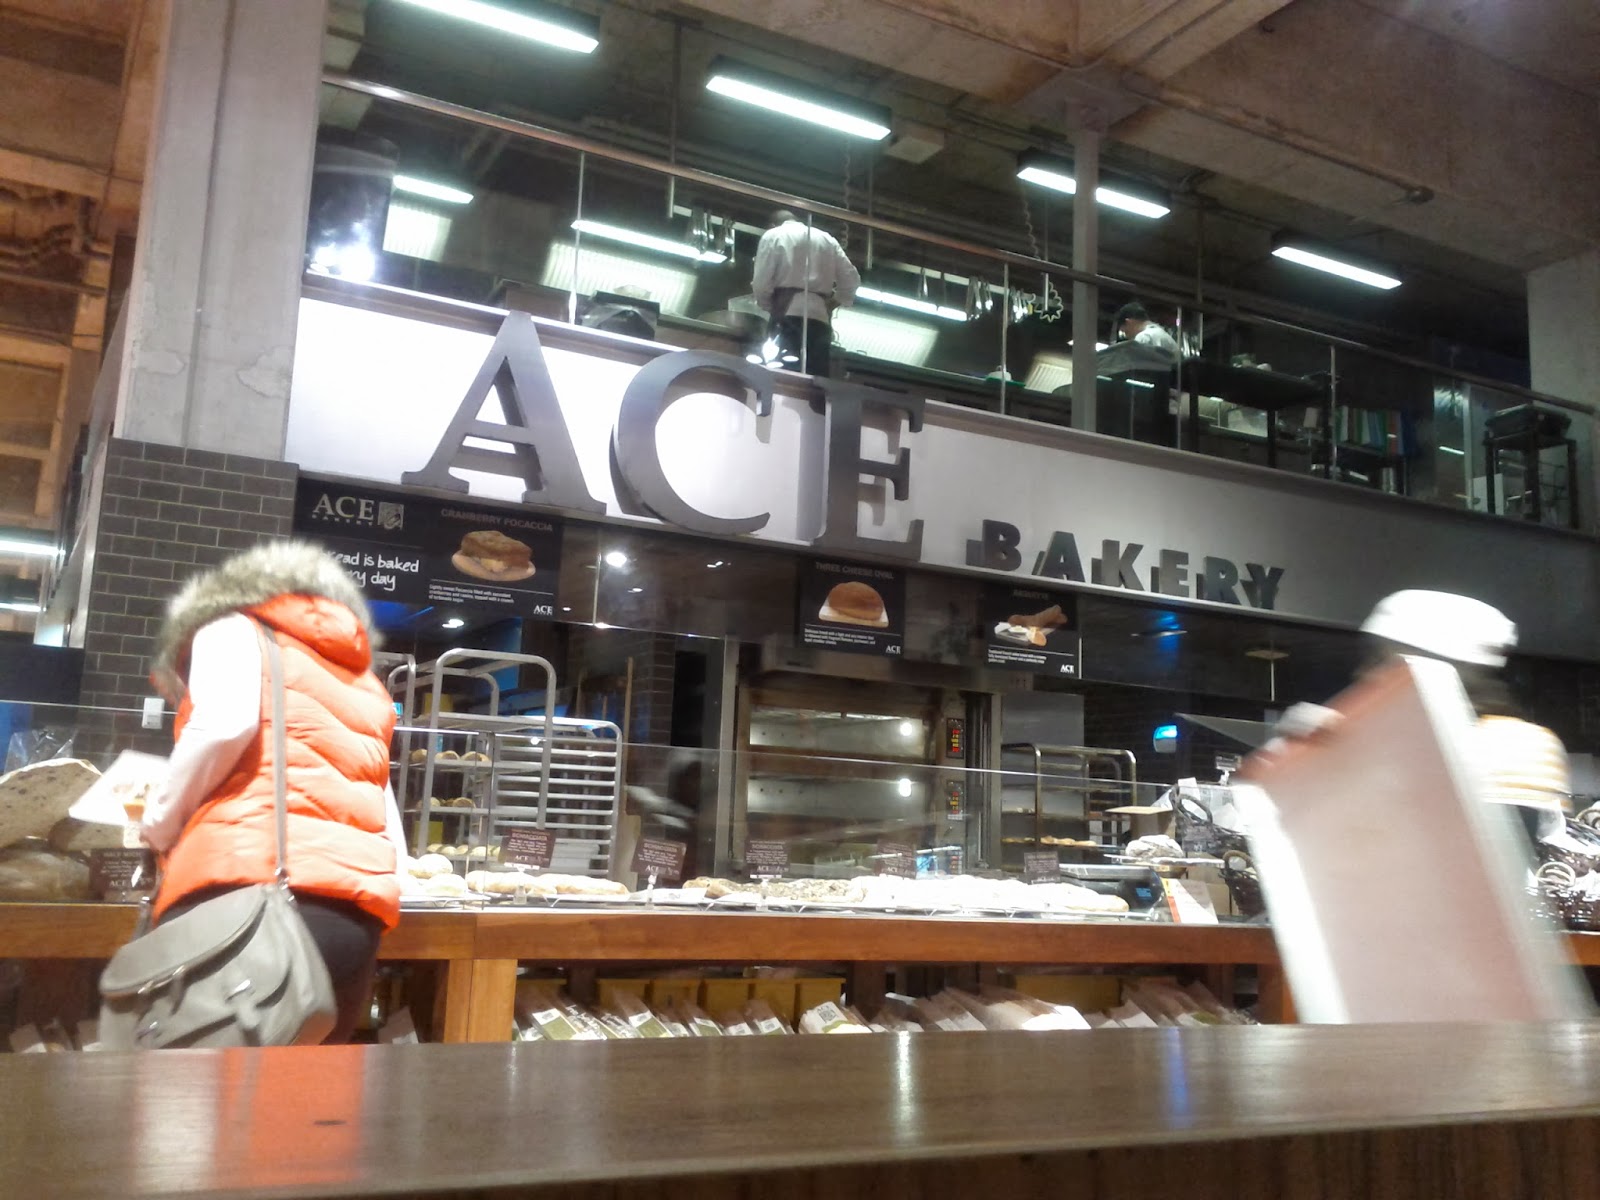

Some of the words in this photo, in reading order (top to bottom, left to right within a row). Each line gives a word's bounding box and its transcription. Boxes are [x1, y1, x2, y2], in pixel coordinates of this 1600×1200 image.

[402, 310, 926, 563] ACE
[980, 518, 1286, 610] BAKERY
[312, 493, 375, 521] ACE
[441, 508, 501, 525] CRANBERRY
[503, 517, 553, 531] FOCACCIA
[363, 553, 375, 567] is
[377, 553, 420, 573] baked
[370, 571, 397, 592] day
[534, 604, 554, 613] ACE
[885, 645, 901, 654] ACE
